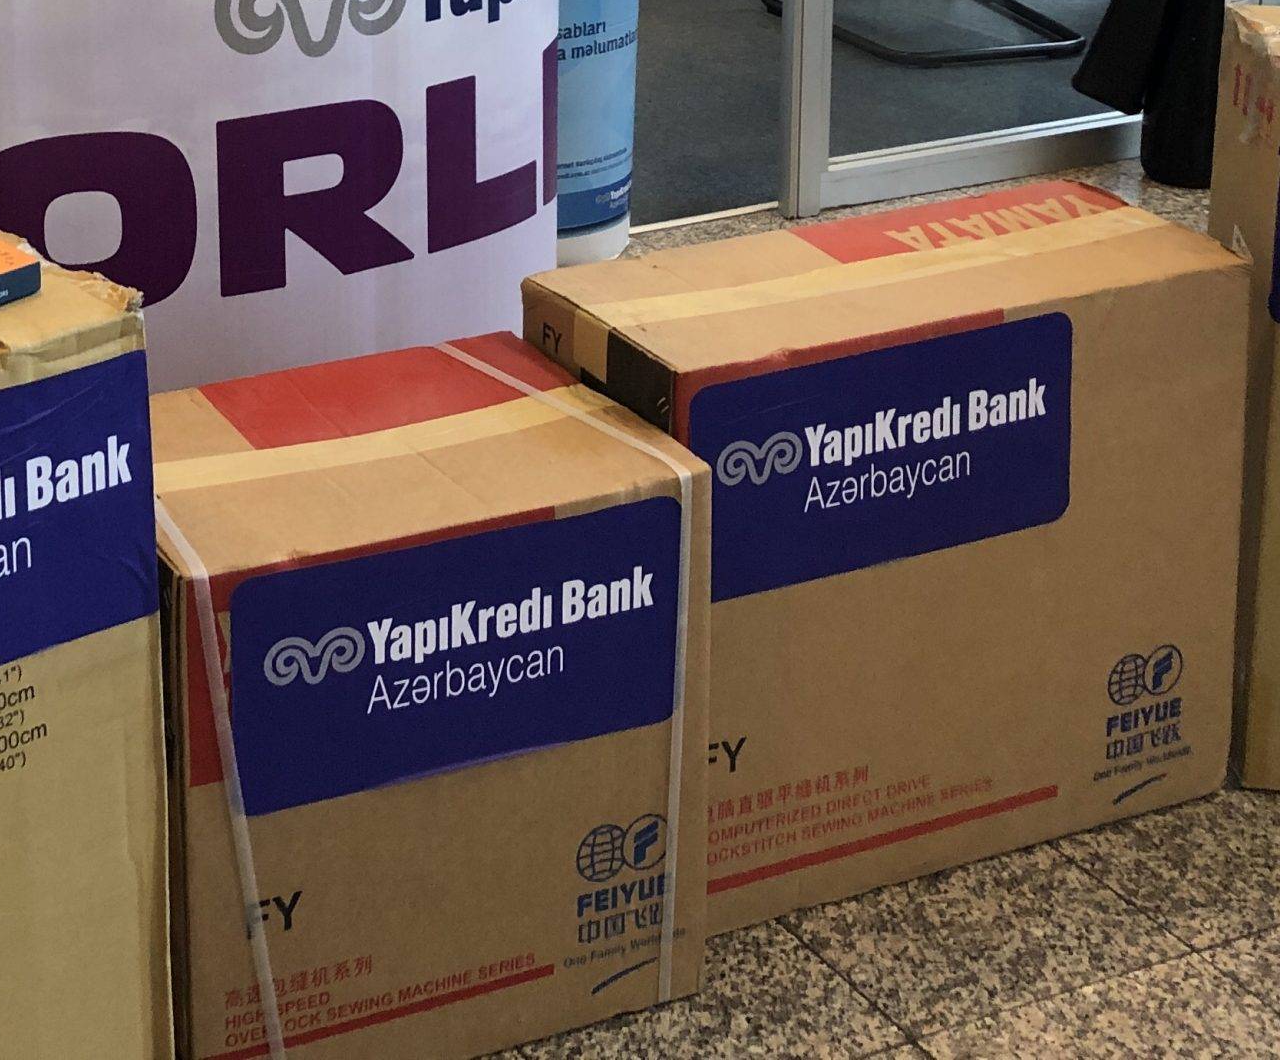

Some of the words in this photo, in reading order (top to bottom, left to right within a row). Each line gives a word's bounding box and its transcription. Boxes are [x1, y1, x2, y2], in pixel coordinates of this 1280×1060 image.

[571, 28, 638, 59] məlumatla
[542, 322, 562, 354] FY
[967, 377, 1048, 431] Bank
[24, 434, 133, 512] Bank
[803, 447, 972, 514] Azərbaycan
[561, 565, 654, 625] Bank
[366, 644, 565, 714] Azərbaycan
[1106, 697, 1182, 737] FEIYUE
[706, 830, 797, 866] OCKSTITCH
[708, 806, 821, 845] OMPUTERIZED
[224, 1012, 320, 1048] OVEROCK
[326, 992, 394, 1019] SEWING
[398, 970, 471, 1003] MACHINE
[478, 952, 536, 981] SERIES
